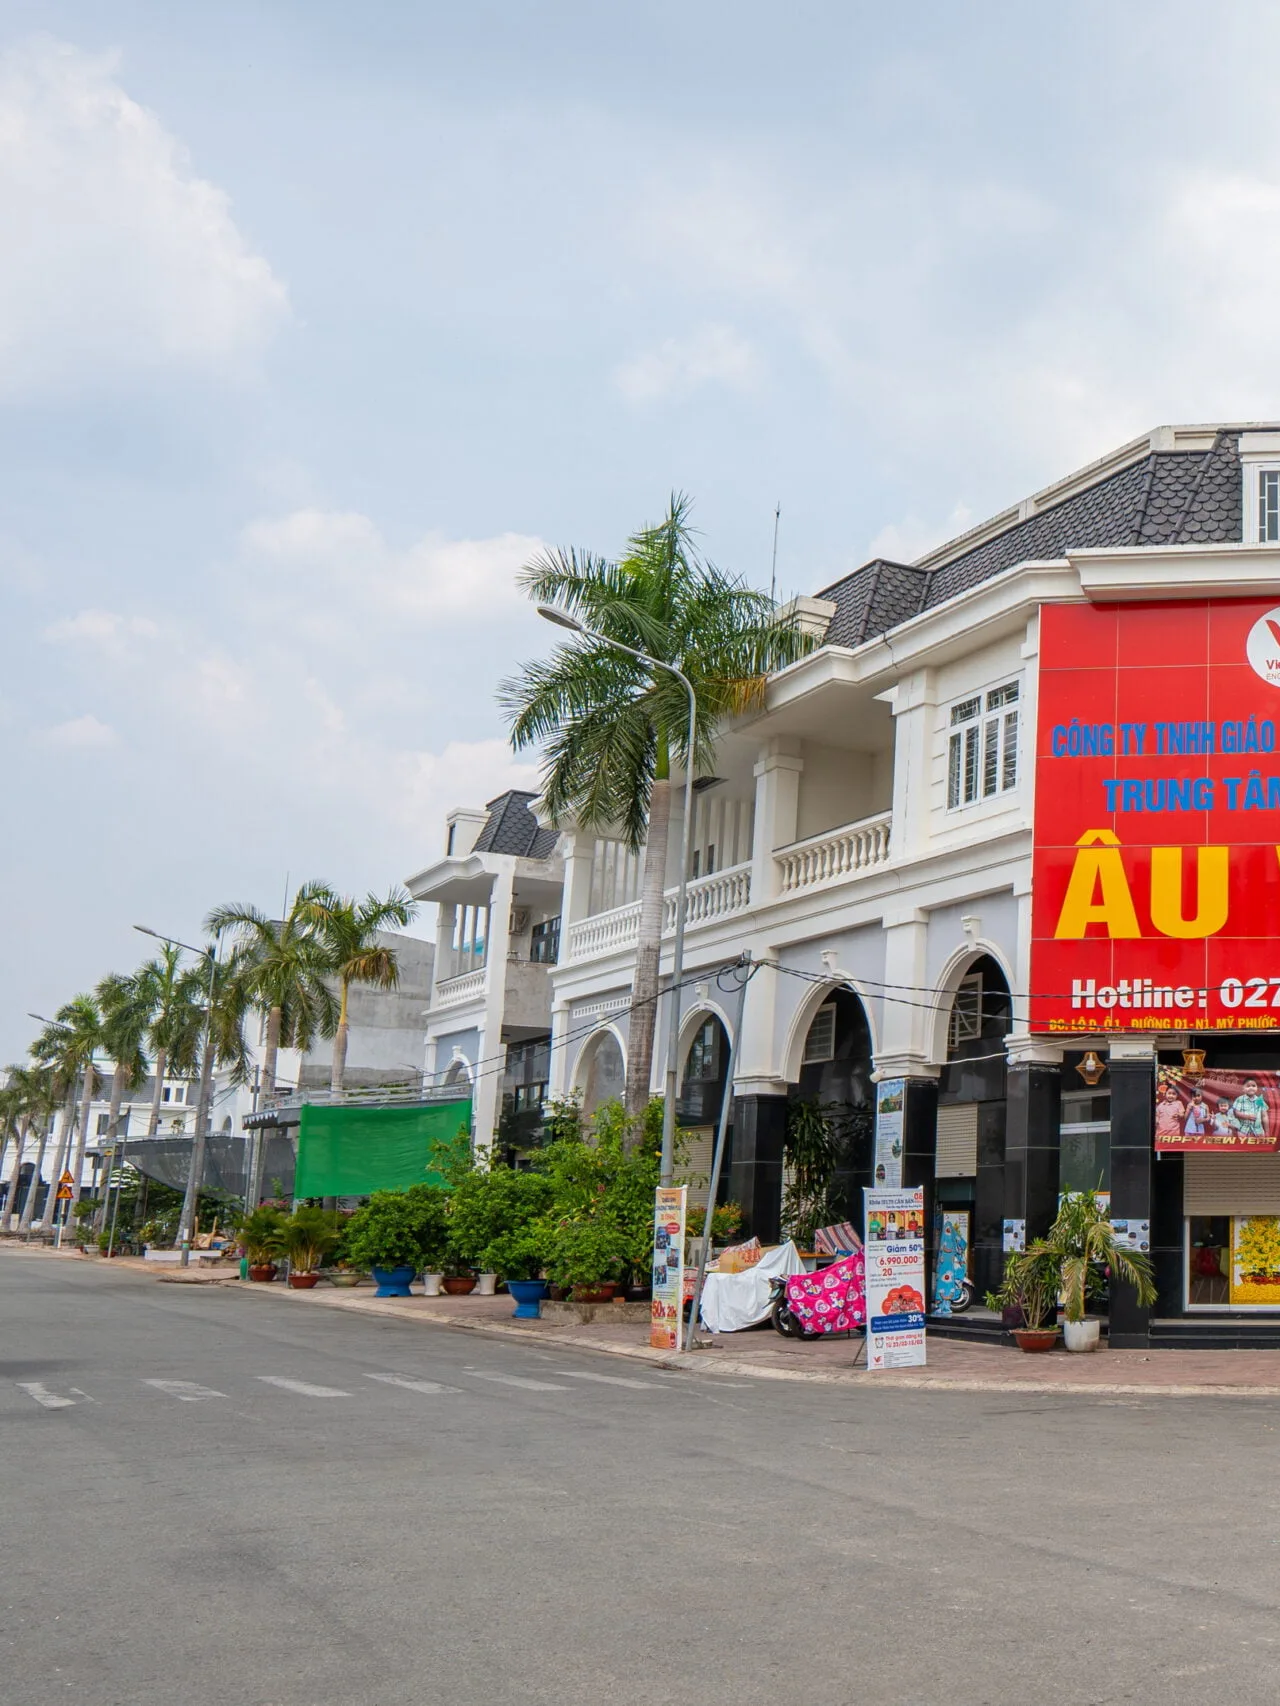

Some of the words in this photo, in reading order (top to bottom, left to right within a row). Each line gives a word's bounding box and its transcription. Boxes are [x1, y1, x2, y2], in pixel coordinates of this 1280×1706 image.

[1052, 717, 1114, 757] CÔNG
[1119, 723, 1147, 755] TY
[1154, 721, 1215, 755] TNHH
[1221, 714, 1275, 753] GIÁO
[1102, 777, 1214, 812] TRUNG
[1053, 829, 1229, 940] ÂU
[1071, 978, 1208, 1009] Hotline:
[1216, 1015, 1235, 1029] MỸ
[1238, 1136, 1277, 1145] YEAR
[887, 1244, 906, 1253] Giảm
[880, 1256, 918, 1265] 6.990.000
[882, 1268, 892, 1276] 20
[908, 1314, 924, 1322] 30%
